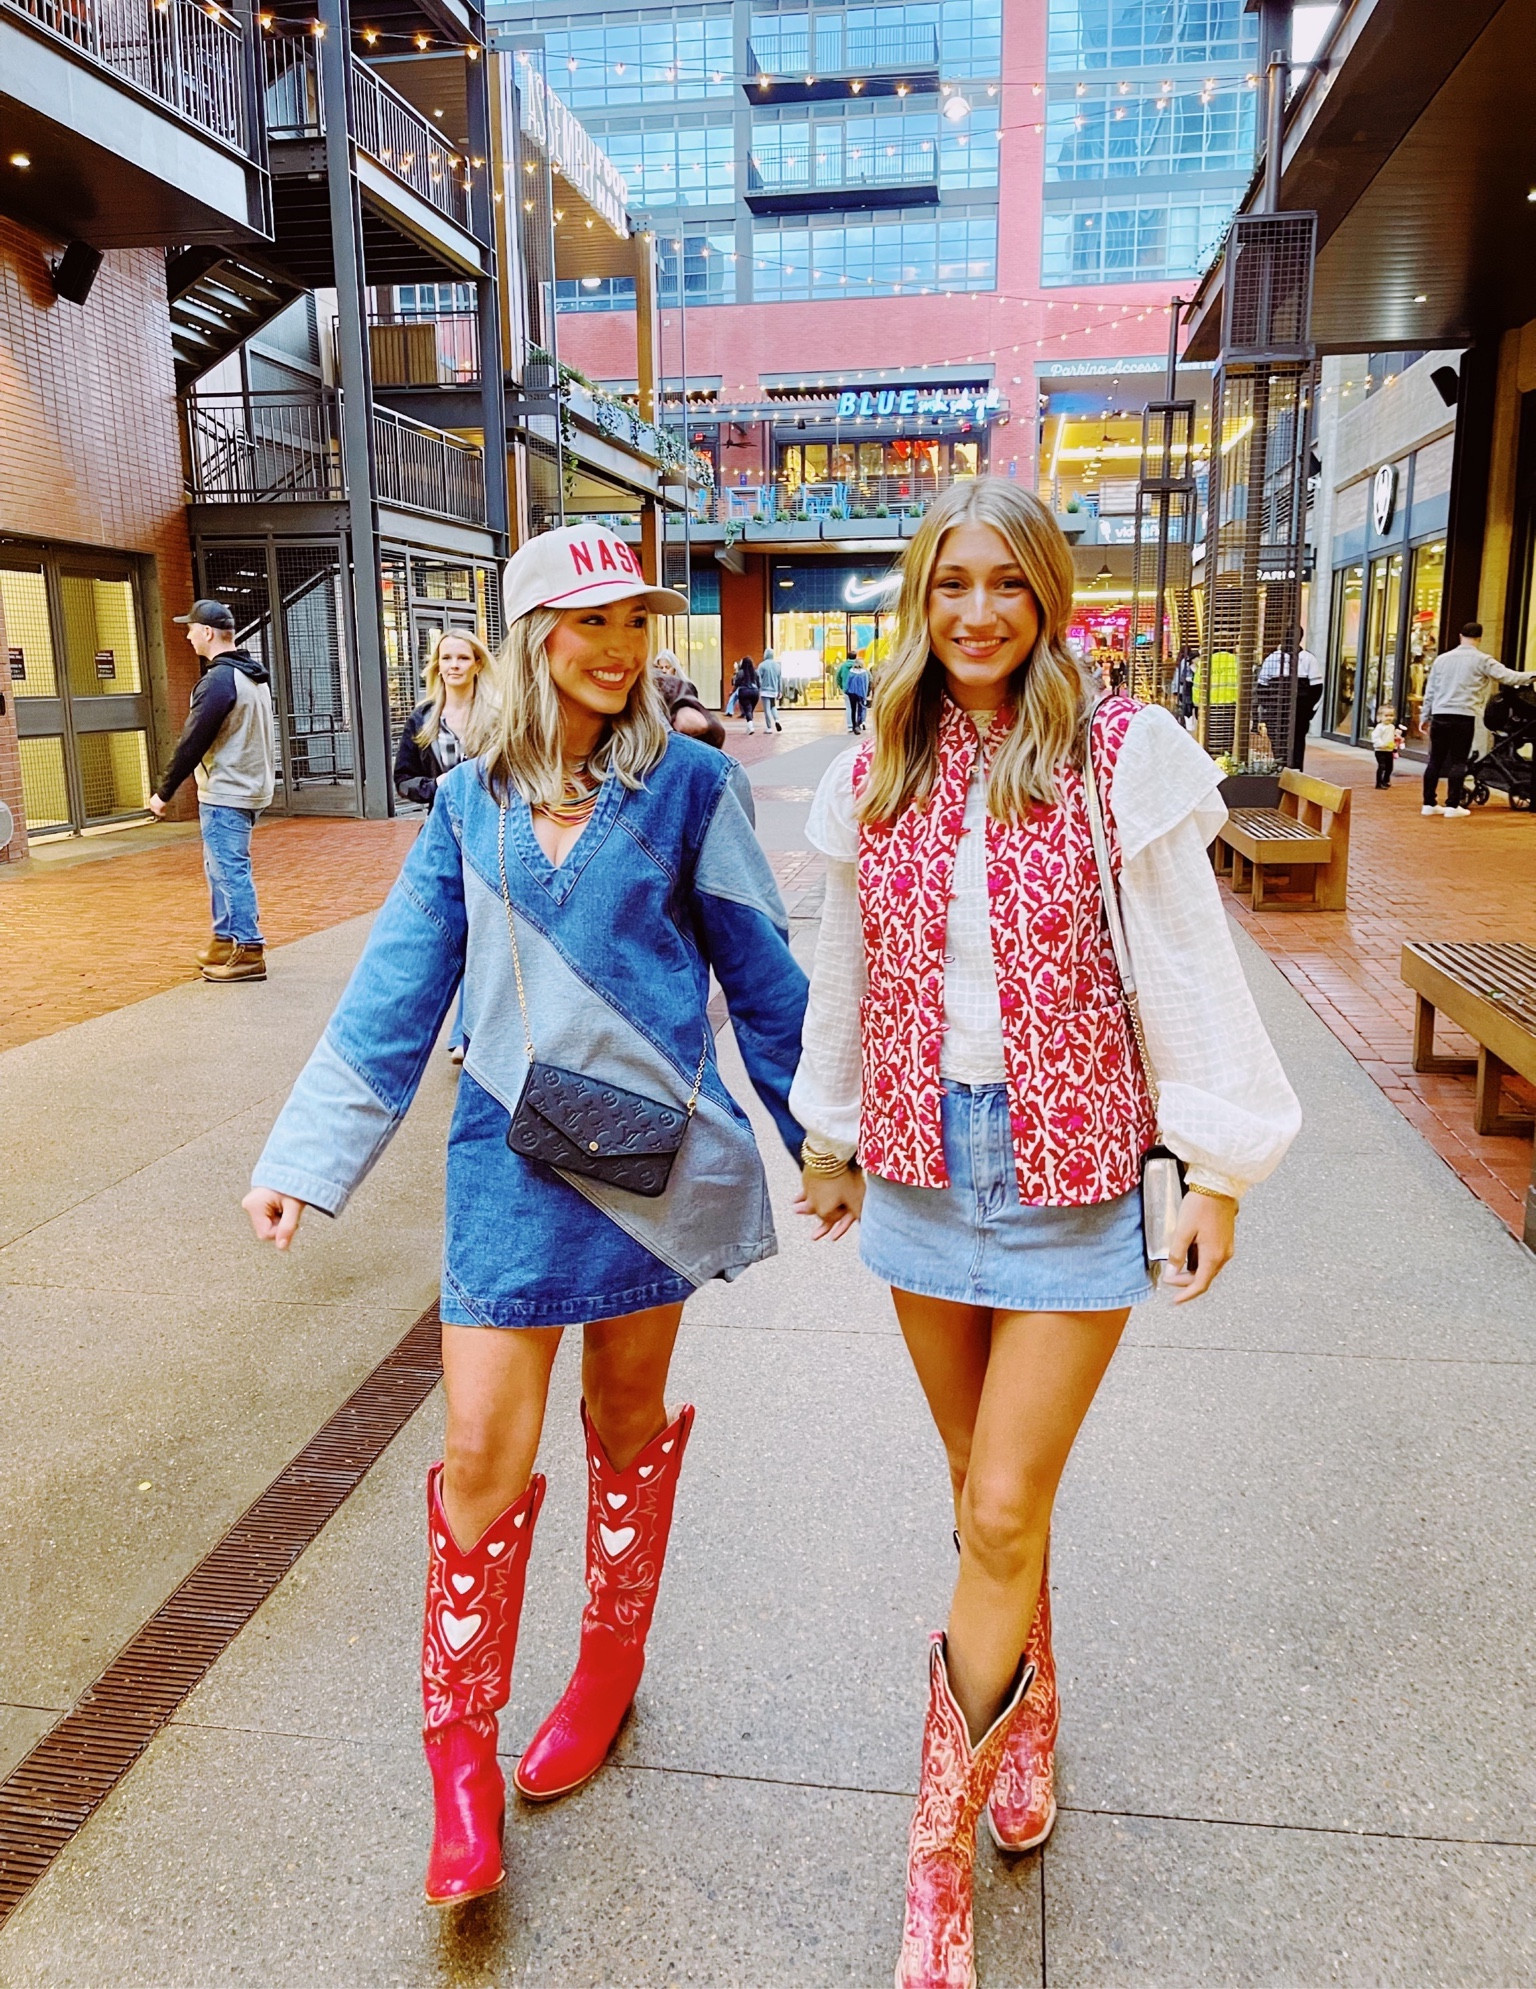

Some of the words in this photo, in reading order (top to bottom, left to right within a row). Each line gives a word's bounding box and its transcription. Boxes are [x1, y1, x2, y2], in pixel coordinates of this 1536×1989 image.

[596, 145, 628, 205] FOOD
[597, 180, 630, 240] HALL
[1108, 359, 1161, 375] Access
[837, 389, 917, 416] BLUE
